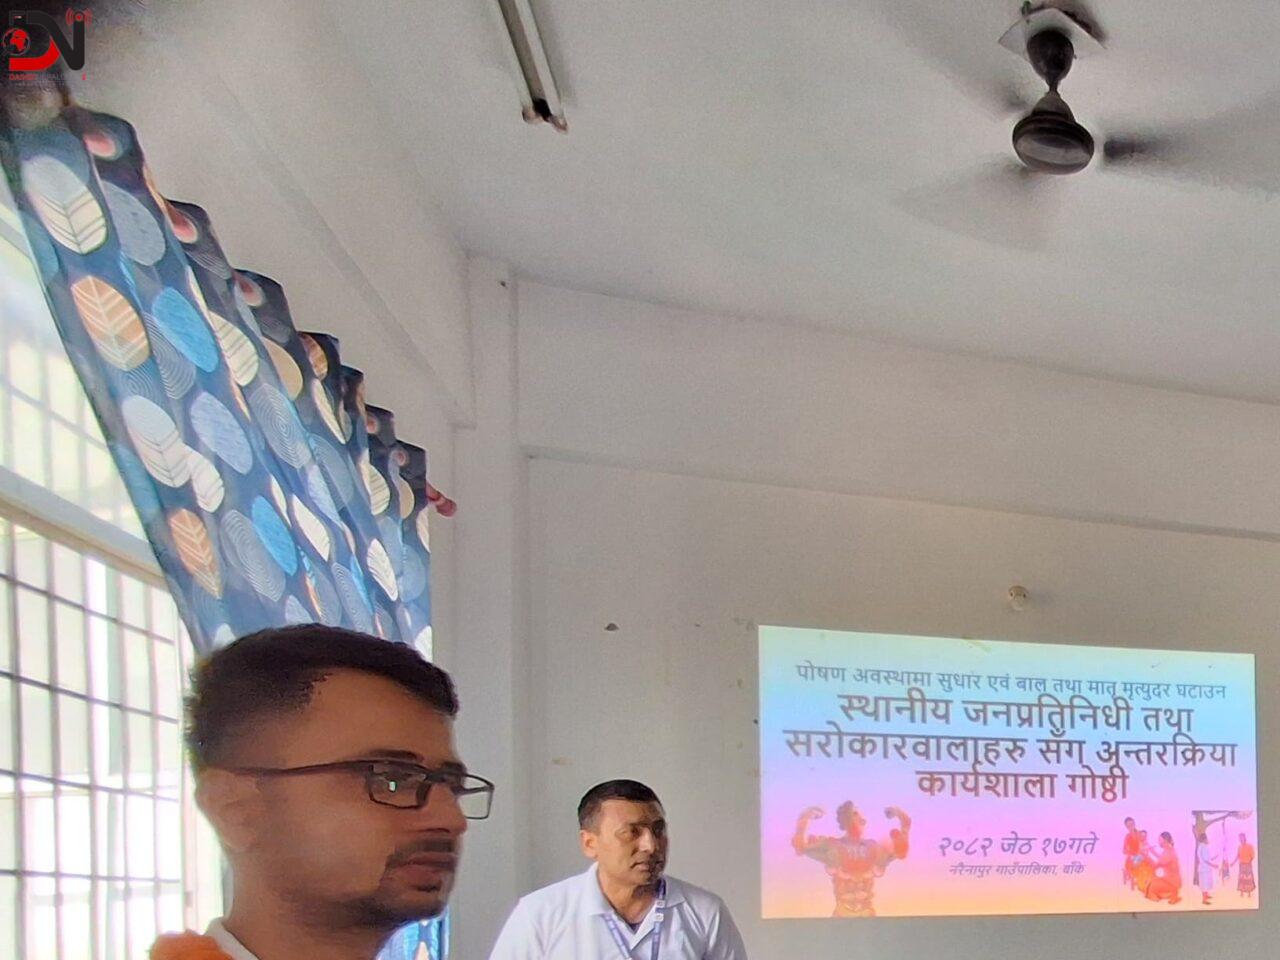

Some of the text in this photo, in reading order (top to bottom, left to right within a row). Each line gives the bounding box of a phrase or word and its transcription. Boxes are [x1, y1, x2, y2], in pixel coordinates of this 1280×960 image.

[796, 660, 846, 682] पोषण
[853, 668, 931, 688] अवस्थामा
[987, 674, 1010, 693] एवं
[1015, 677, 1047, 693] बाल
[1052, 678, 1082, 695] तथा
[1122, 682, 1172, 700] मृत्युदर
[1176, 684, 1228, 700] घटाउन
[837, 687, 1195, 732] स्थानीय जनप्रतिनिधी तथा
[782, 720, 1239, 767] सरोकारवालाहरु सँग अन्तरक्रिया
[915, 760, 1130, 803] कार्यशाला गोष्ठी
[938, 836, 994, 857] २०८२
[1000, 831, 1038, 855] जेठ
